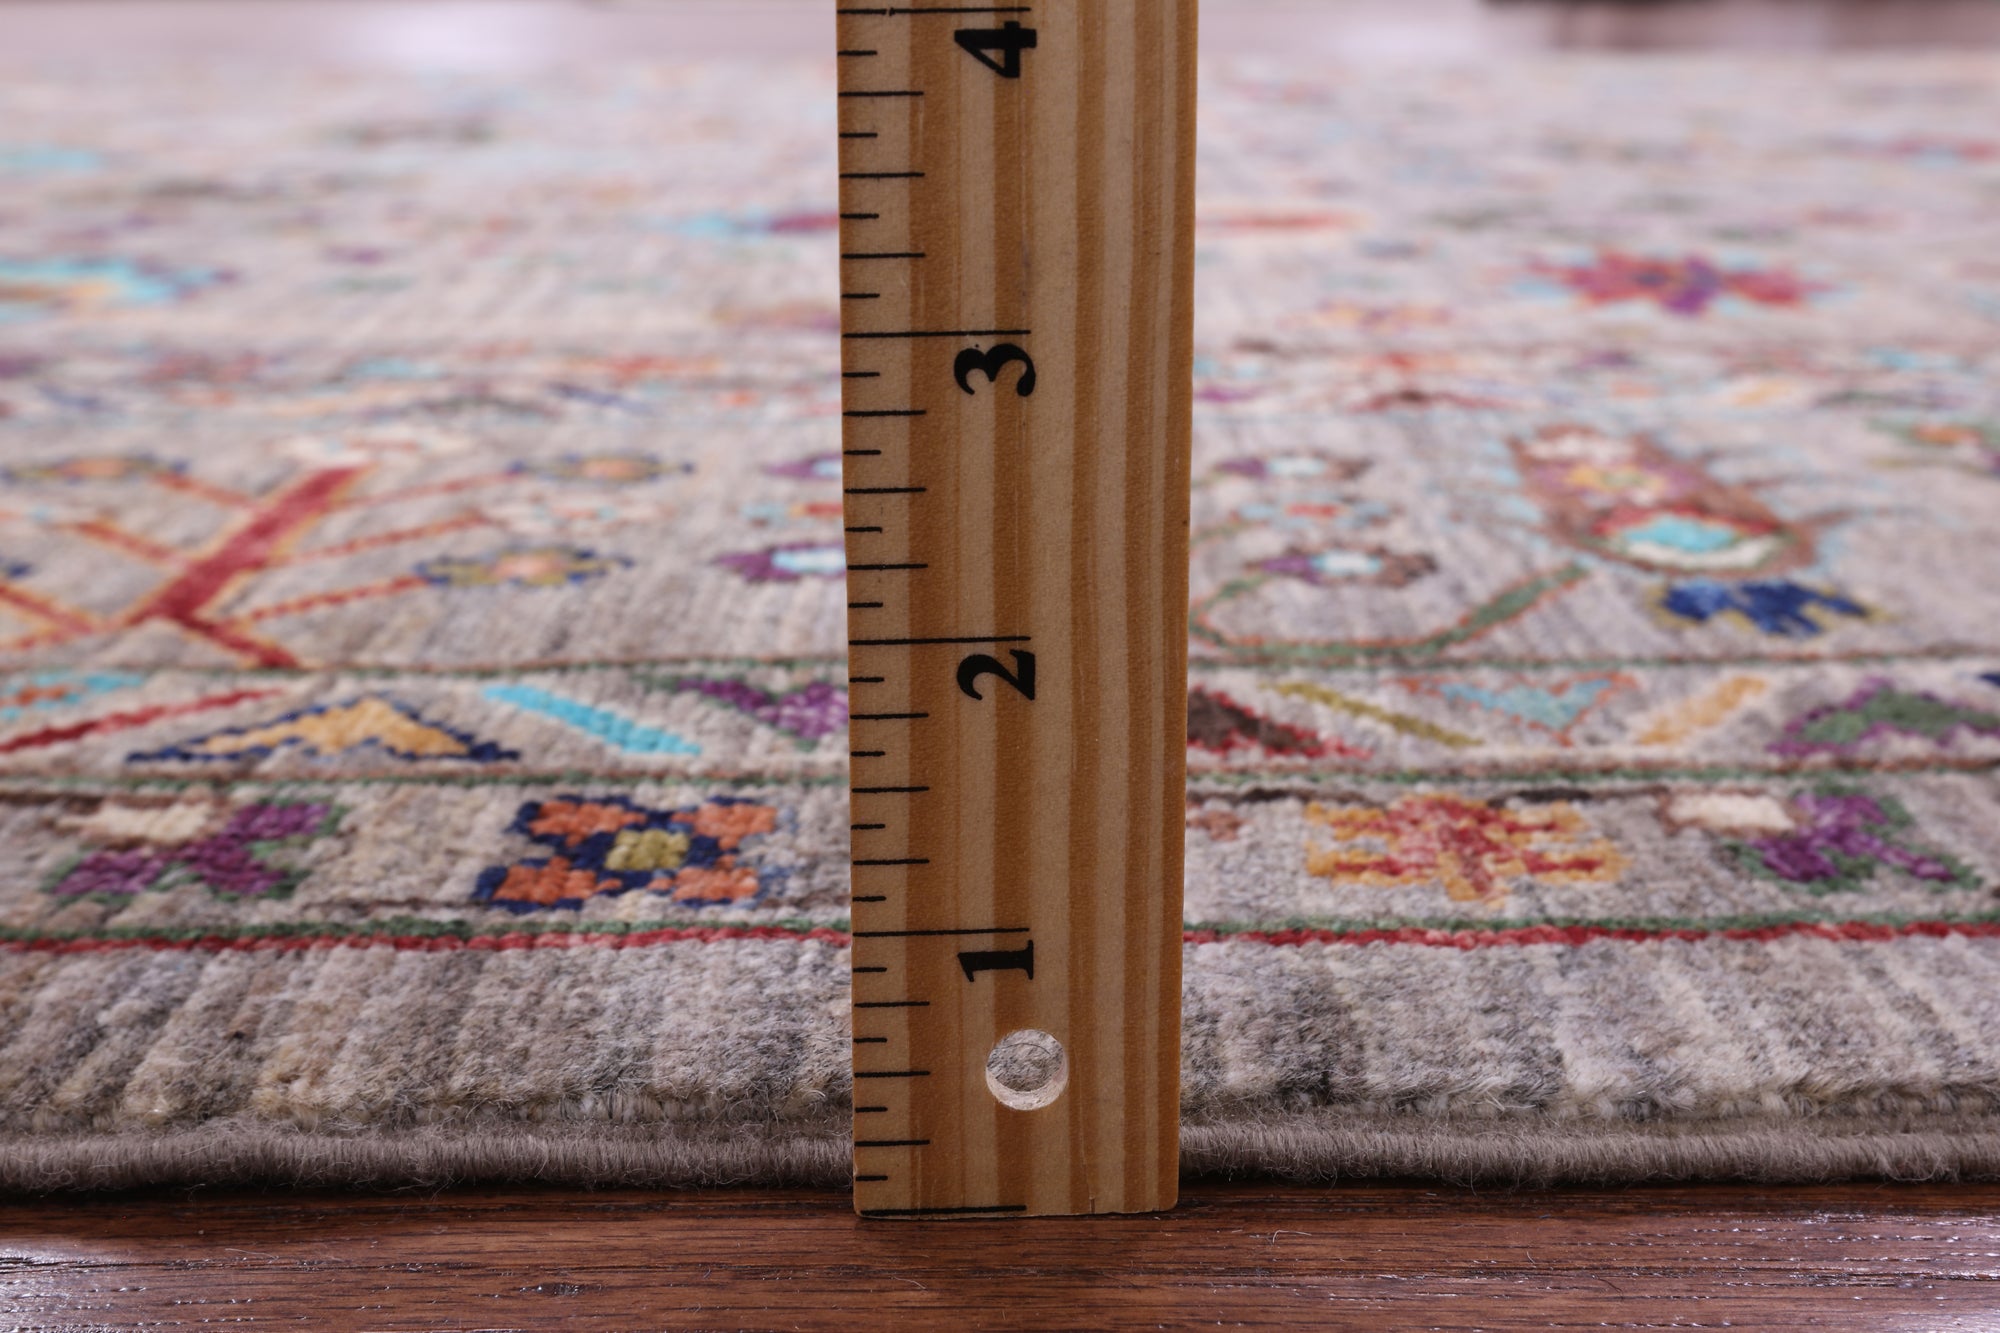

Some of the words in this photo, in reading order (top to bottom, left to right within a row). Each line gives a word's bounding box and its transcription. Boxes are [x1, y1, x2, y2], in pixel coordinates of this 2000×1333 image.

[954, 20, 1038, 80] 4
[953, 342, 1037, 398] 3
[956, 648, 1037, 701] 2
[956, 939, 1035, 983] 1
